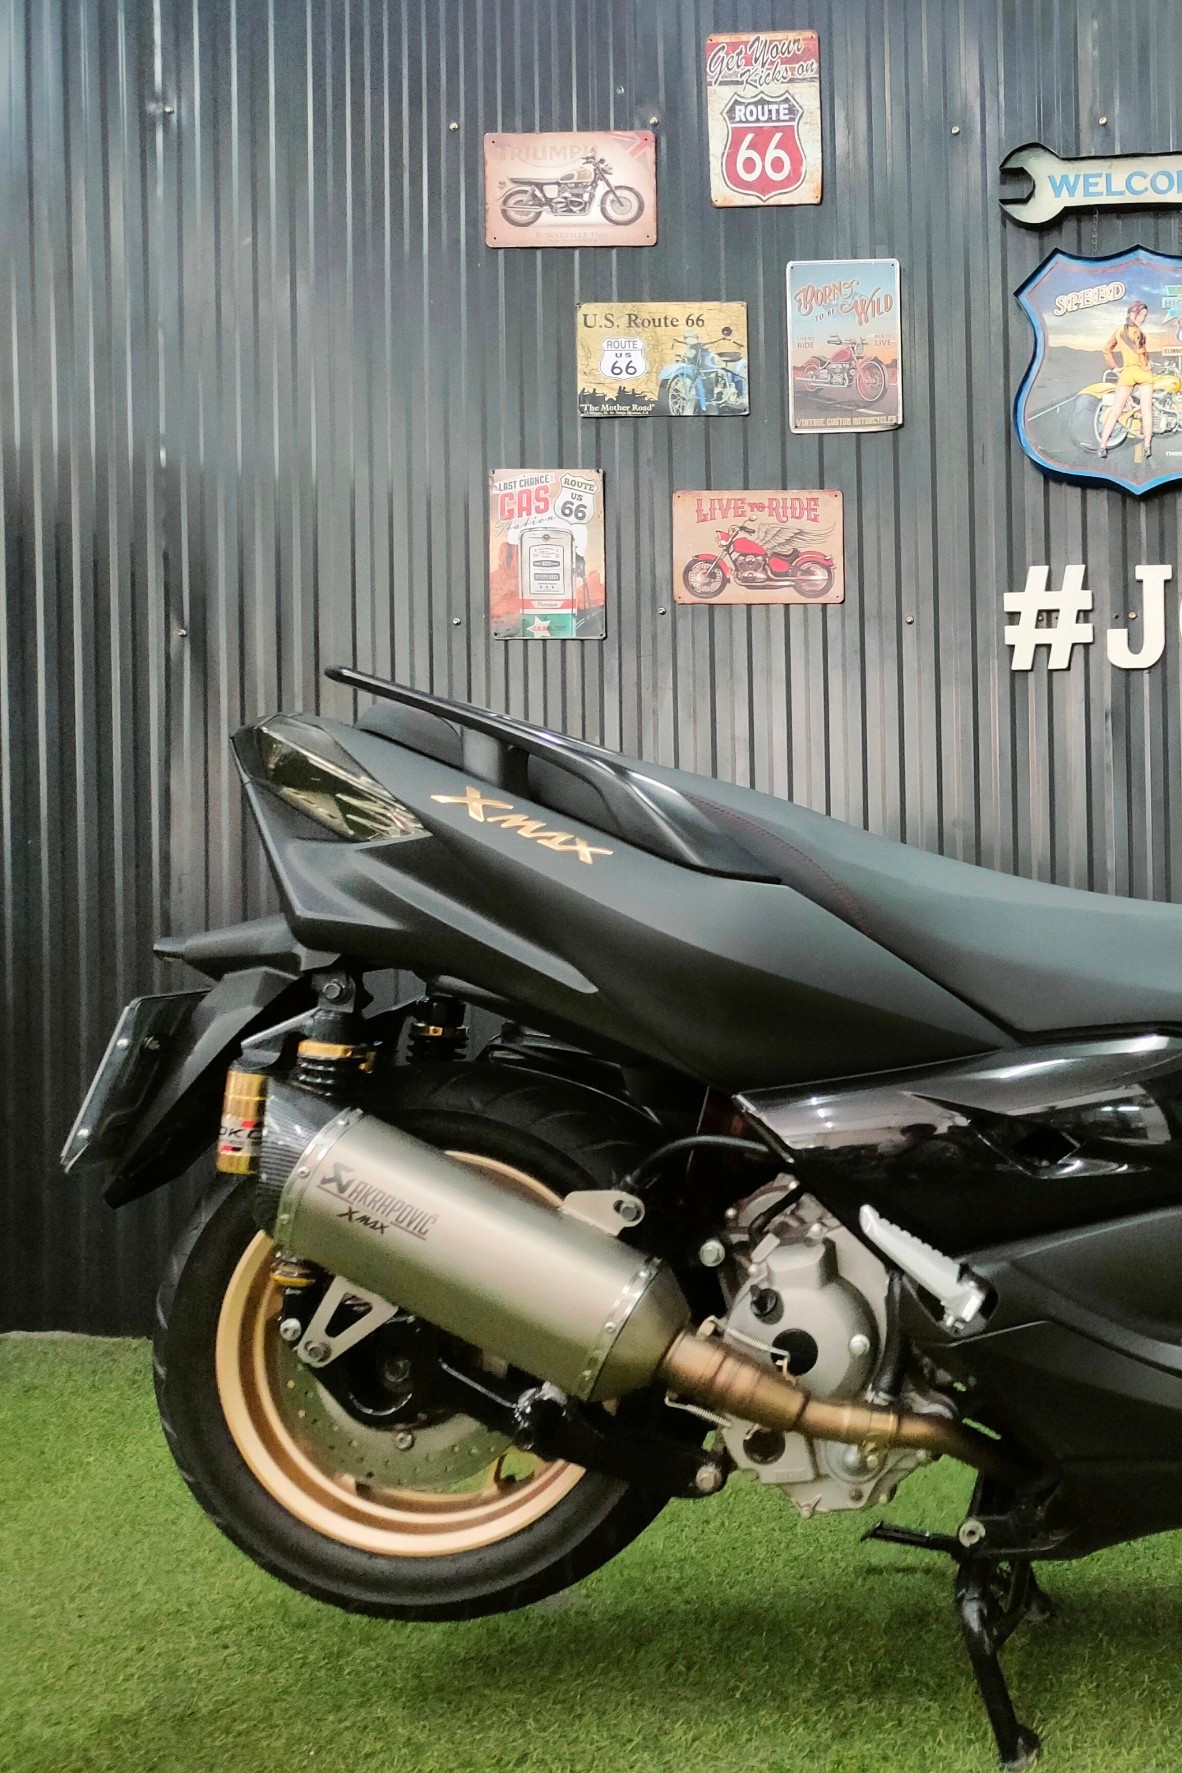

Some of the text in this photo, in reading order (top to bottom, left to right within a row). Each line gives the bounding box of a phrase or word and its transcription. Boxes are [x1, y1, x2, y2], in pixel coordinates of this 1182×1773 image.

[707, 35, 803, 86] Get Your
[739, 60, 816, 92] Kicks on
[734, 104, 790, 121] ROUTE
[497, 144, 599, 161] TRIUMPH
[736, 132, 791, 182] 66
[794, 279, 859, 317] BORN
[1053, 281, 1126, 317] SPEED
[840, 287, 893, 327] WILD
[582, 312, 706, 329] U.S. Route 66
[815, 313, 824, 322] TO
[606, 340, 638, 350] ROUTE
[797, 341, 815, 349] RIDE
[874, 339, 892, 347] LIVE
[610, 360, 638, 376] 66
[600, 403, 630, 412] Mother
[498, 474, 550, 492] LAST CHANCE
[563, 477, 596, 492] ROUTE
[499, 484, 550, 521] GAS
[570, 492, 584, 502] US
[560, 500, 588, 521] 66
[695, 497, 820, 524] LIVE TO RIDE
[495, 515, 558, 538] Station
